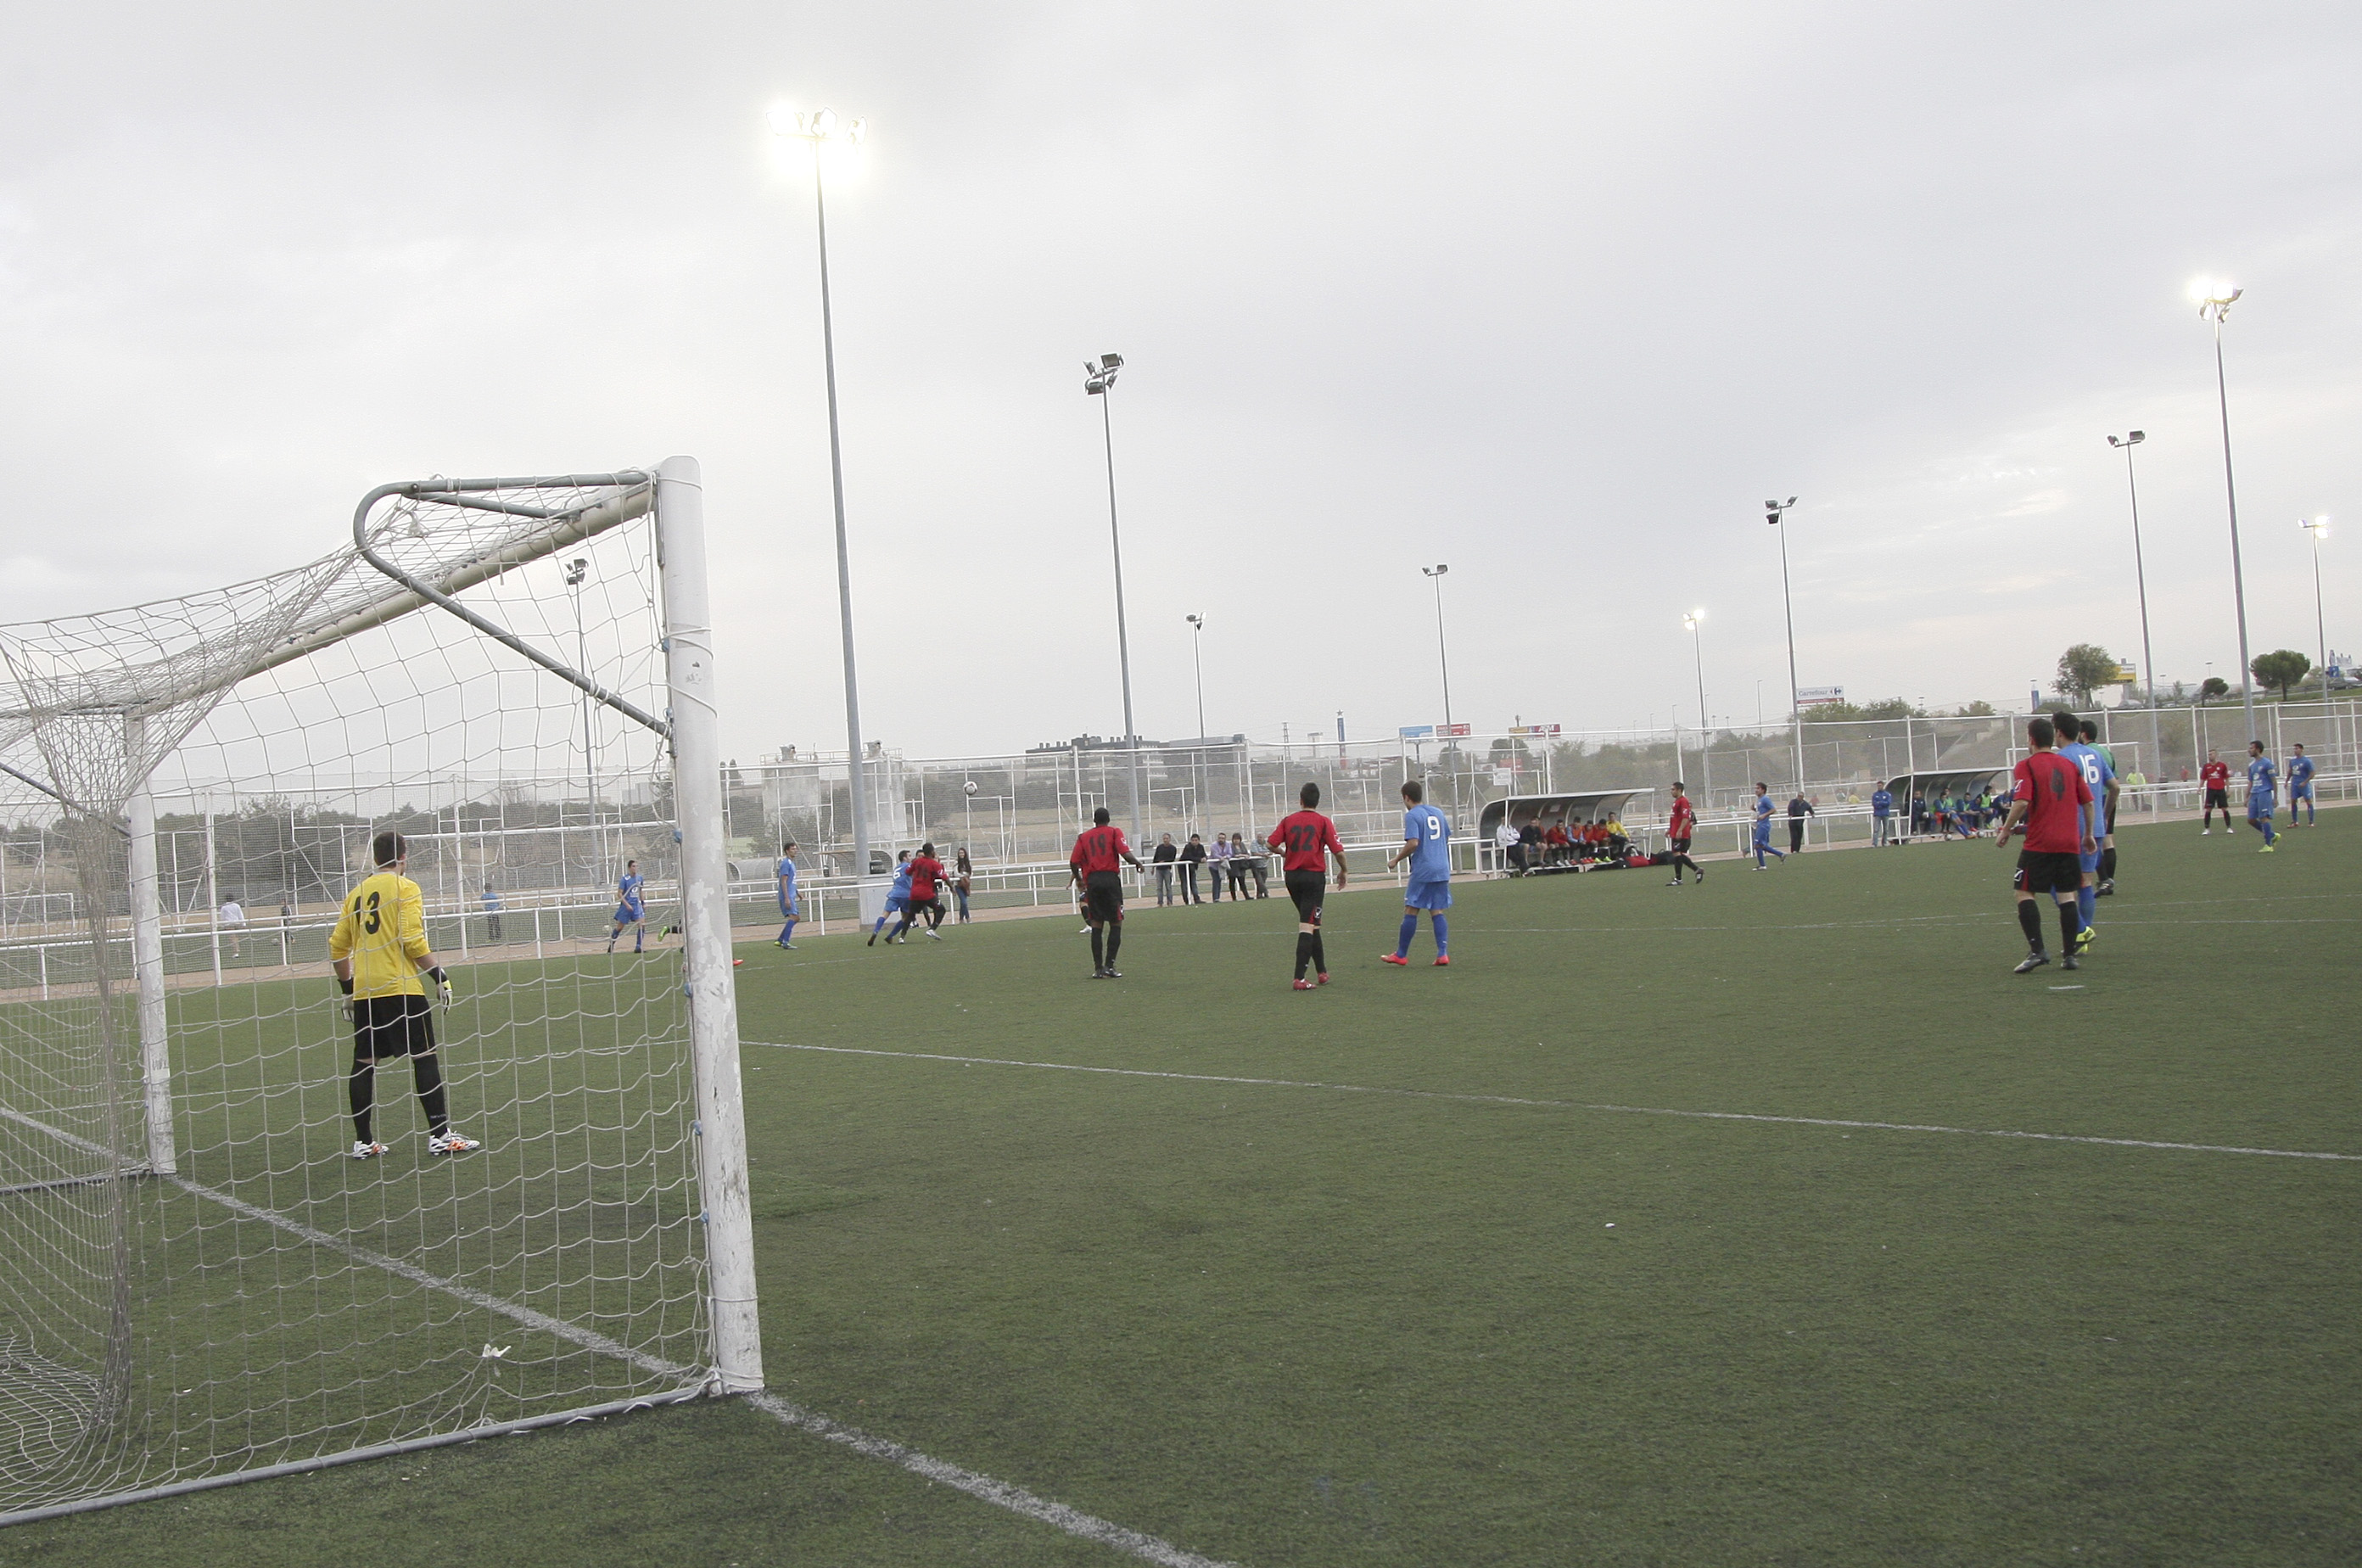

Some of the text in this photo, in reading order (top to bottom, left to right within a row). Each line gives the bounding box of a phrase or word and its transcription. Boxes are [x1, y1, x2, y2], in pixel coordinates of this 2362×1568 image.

[2079, 754, 2100, 784] 16
[1290, 825, 1315, 853] 22
[1427, 815, 1441, 840] 9
[1089, 833, 1107, 857] 19
[354, 891, 380, 935] 13
